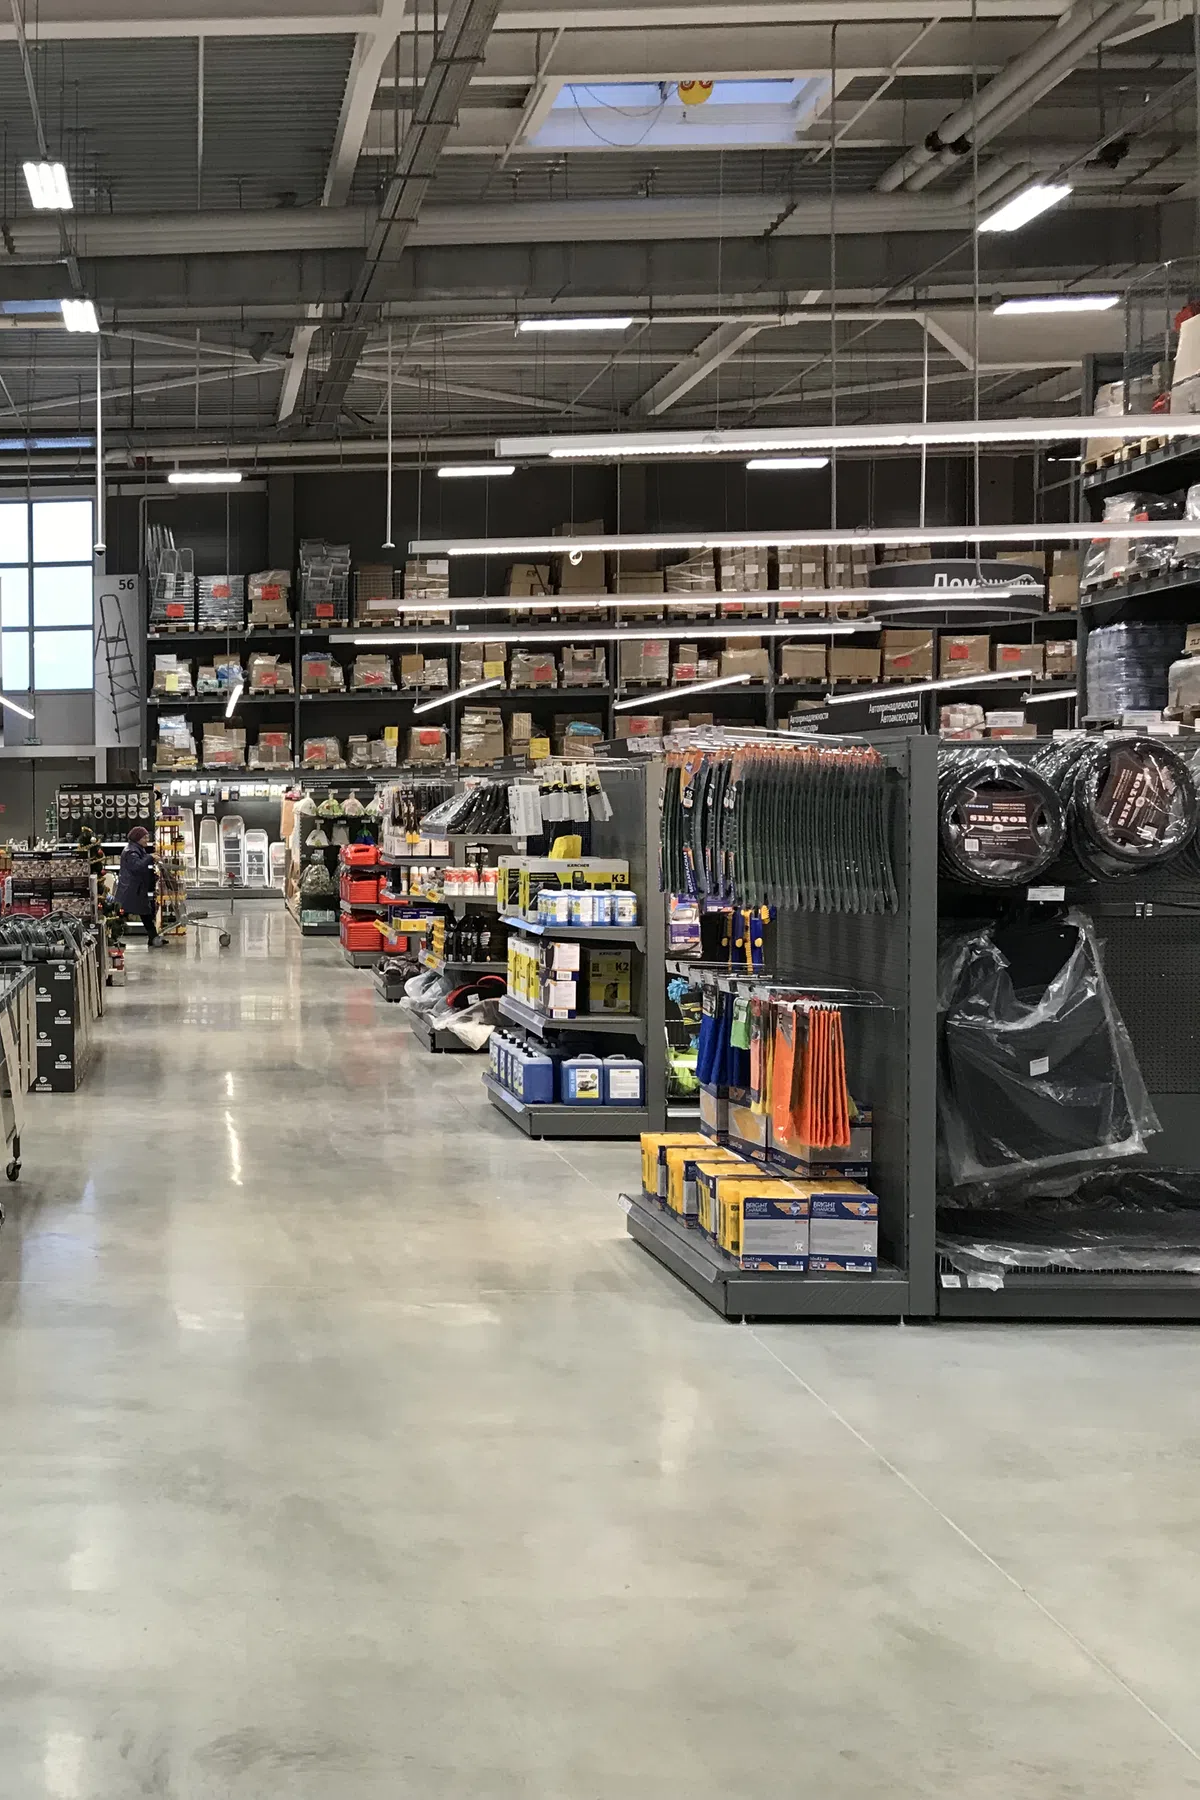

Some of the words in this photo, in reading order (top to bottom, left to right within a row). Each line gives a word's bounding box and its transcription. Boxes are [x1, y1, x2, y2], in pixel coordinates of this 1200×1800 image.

[118, 579, 135, 591] 56
[1117, 772, 1144, 827] SENATOR
[970, 814, 1027, 823] SENATOR
[611, 873, 626, 883] K3
[615, 962, 629, 972] K2
